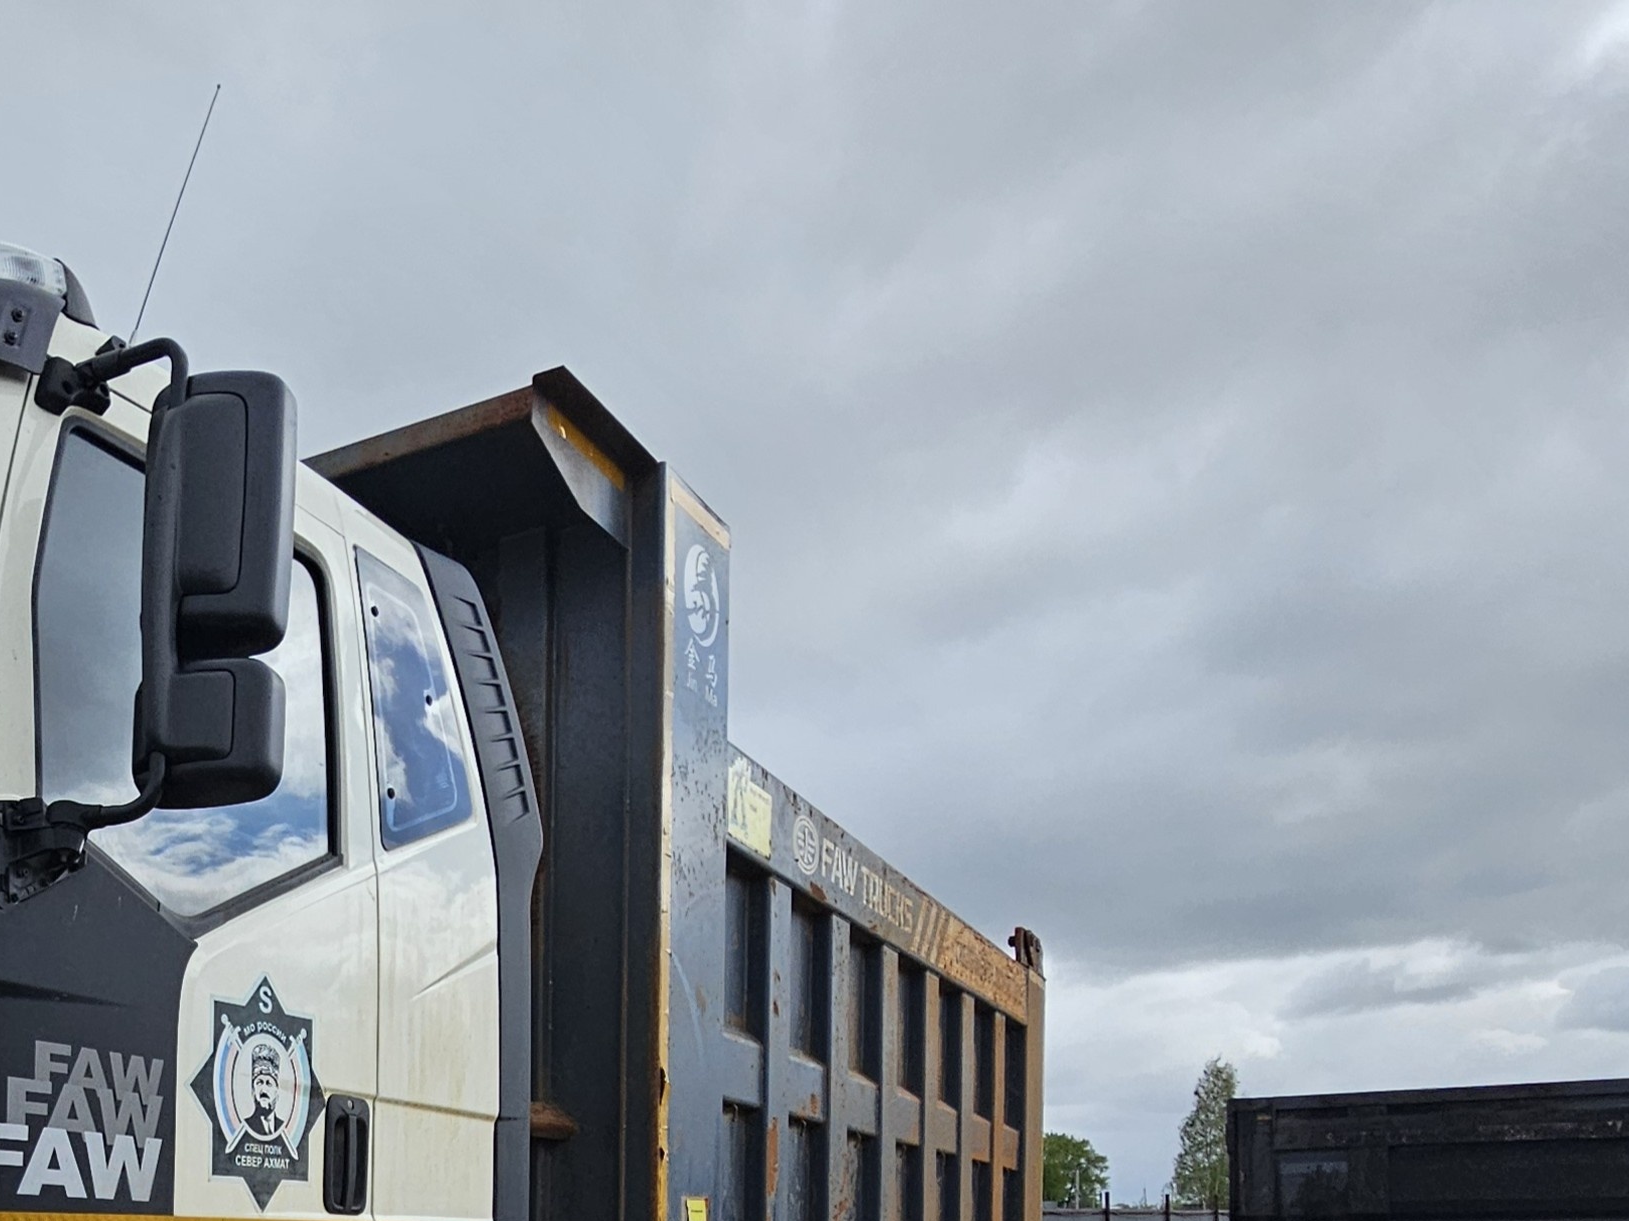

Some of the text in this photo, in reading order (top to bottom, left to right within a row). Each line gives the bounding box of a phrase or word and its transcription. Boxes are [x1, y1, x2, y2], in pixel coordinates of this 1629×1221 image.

[821, 837, 913, 934] FAW TRUCKS
[259, 985, 273, 1014] S
[34, 1039, 165, 1107] FAW
[6, 1075, 164, 1149] FAW
[235, 1154, 291, 1169] СЕВЕР АХМАТ
[244, 1143, 283, 1155] СПЕЦ ПОЛК
